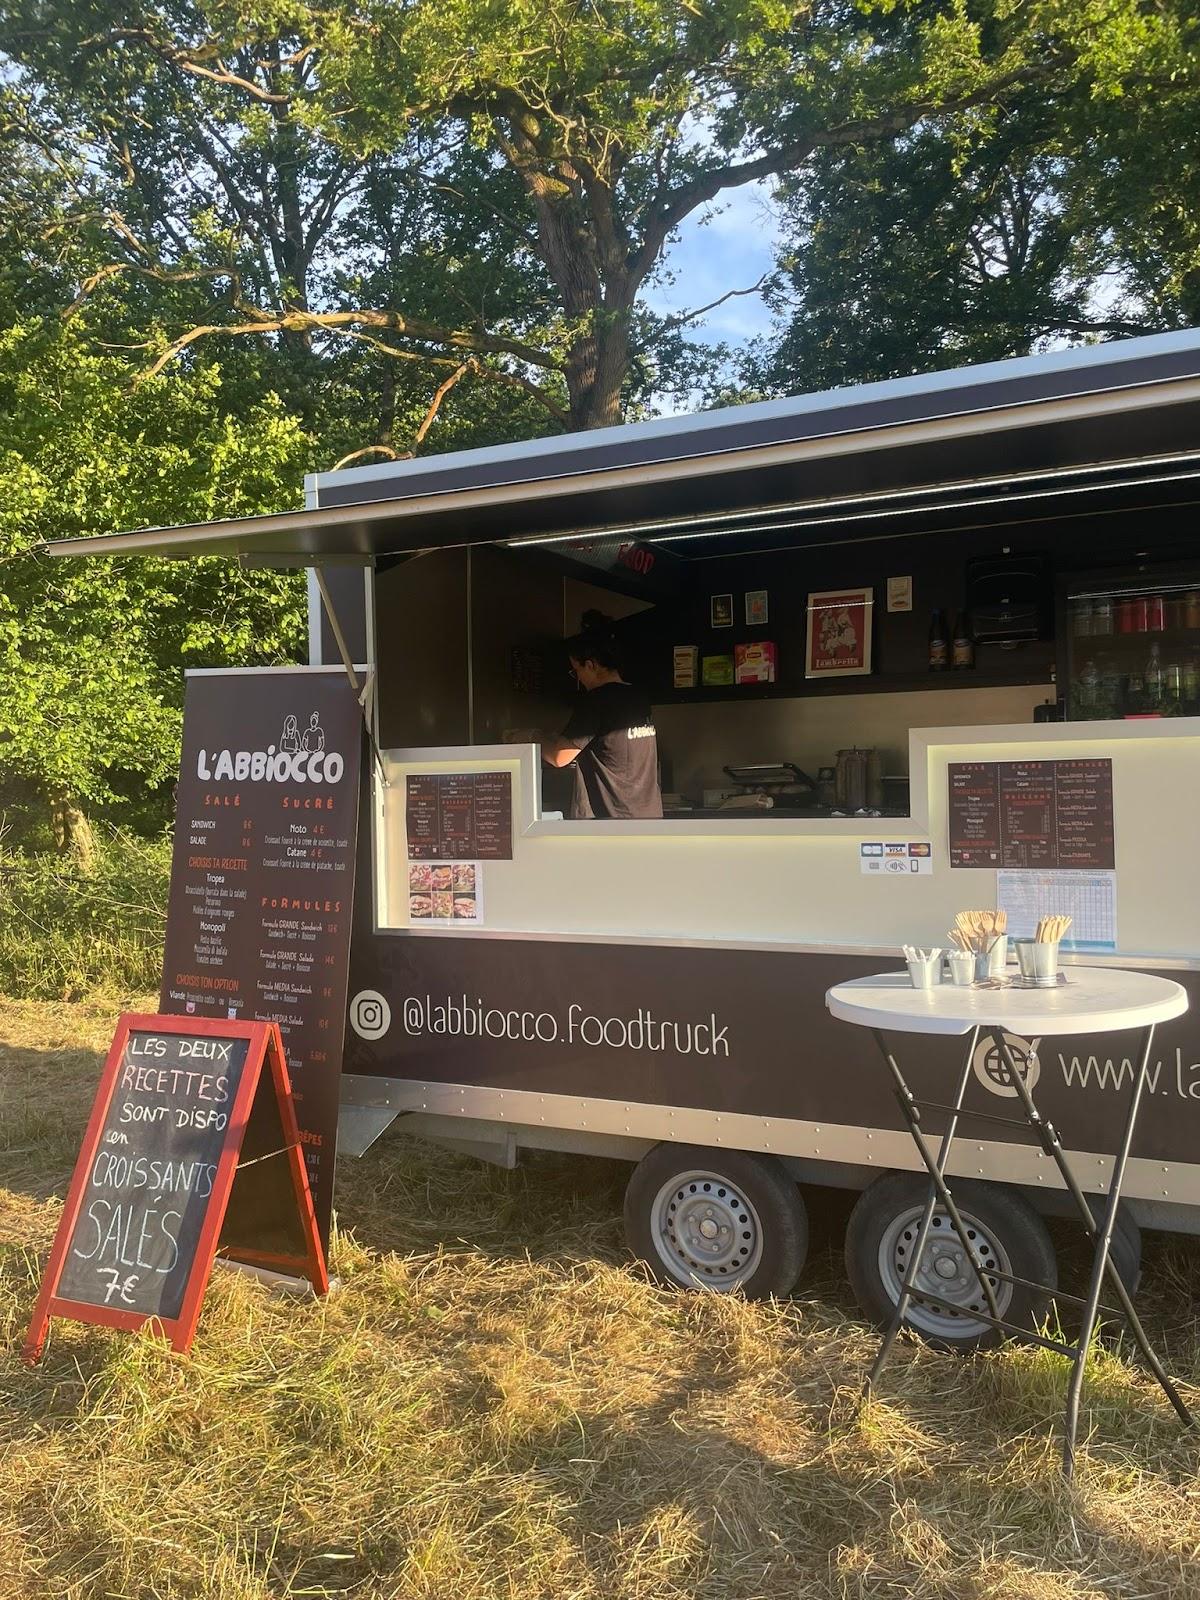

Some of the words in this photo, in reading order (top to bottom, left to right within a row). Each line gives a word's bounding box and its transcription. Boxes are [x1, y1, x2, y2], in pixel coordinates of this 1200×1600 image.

[204, 794, 241, 806] SALÉ
[282, 796, 335, 809] SUCRÉ
[289, 824, 307, 834] Noto
[286, 846, 307, 857] Catane
[207, 873, 225, 886] Tropea
[279, 919, 299, 930] GRANDE
[277, 951, 297, 961] GRANDE
[214, 978, 239, 991] OPTION
[169, 990, 186, 1000] Viande
[403, 993, 729, 1057] @labbiocco.foodtruck
[131, 1039, 167, 1057] LES
[178, 1040, 233, 1061] DEUX
[121, 1064, 229, 1103] RECETTES
[120, 1102, 169, 1123] SONT
[107, 1129, 129, 1145] en
[74, 1195, 182, 1274] SALÉS
[96, 1267, 140, 1305] 7€
